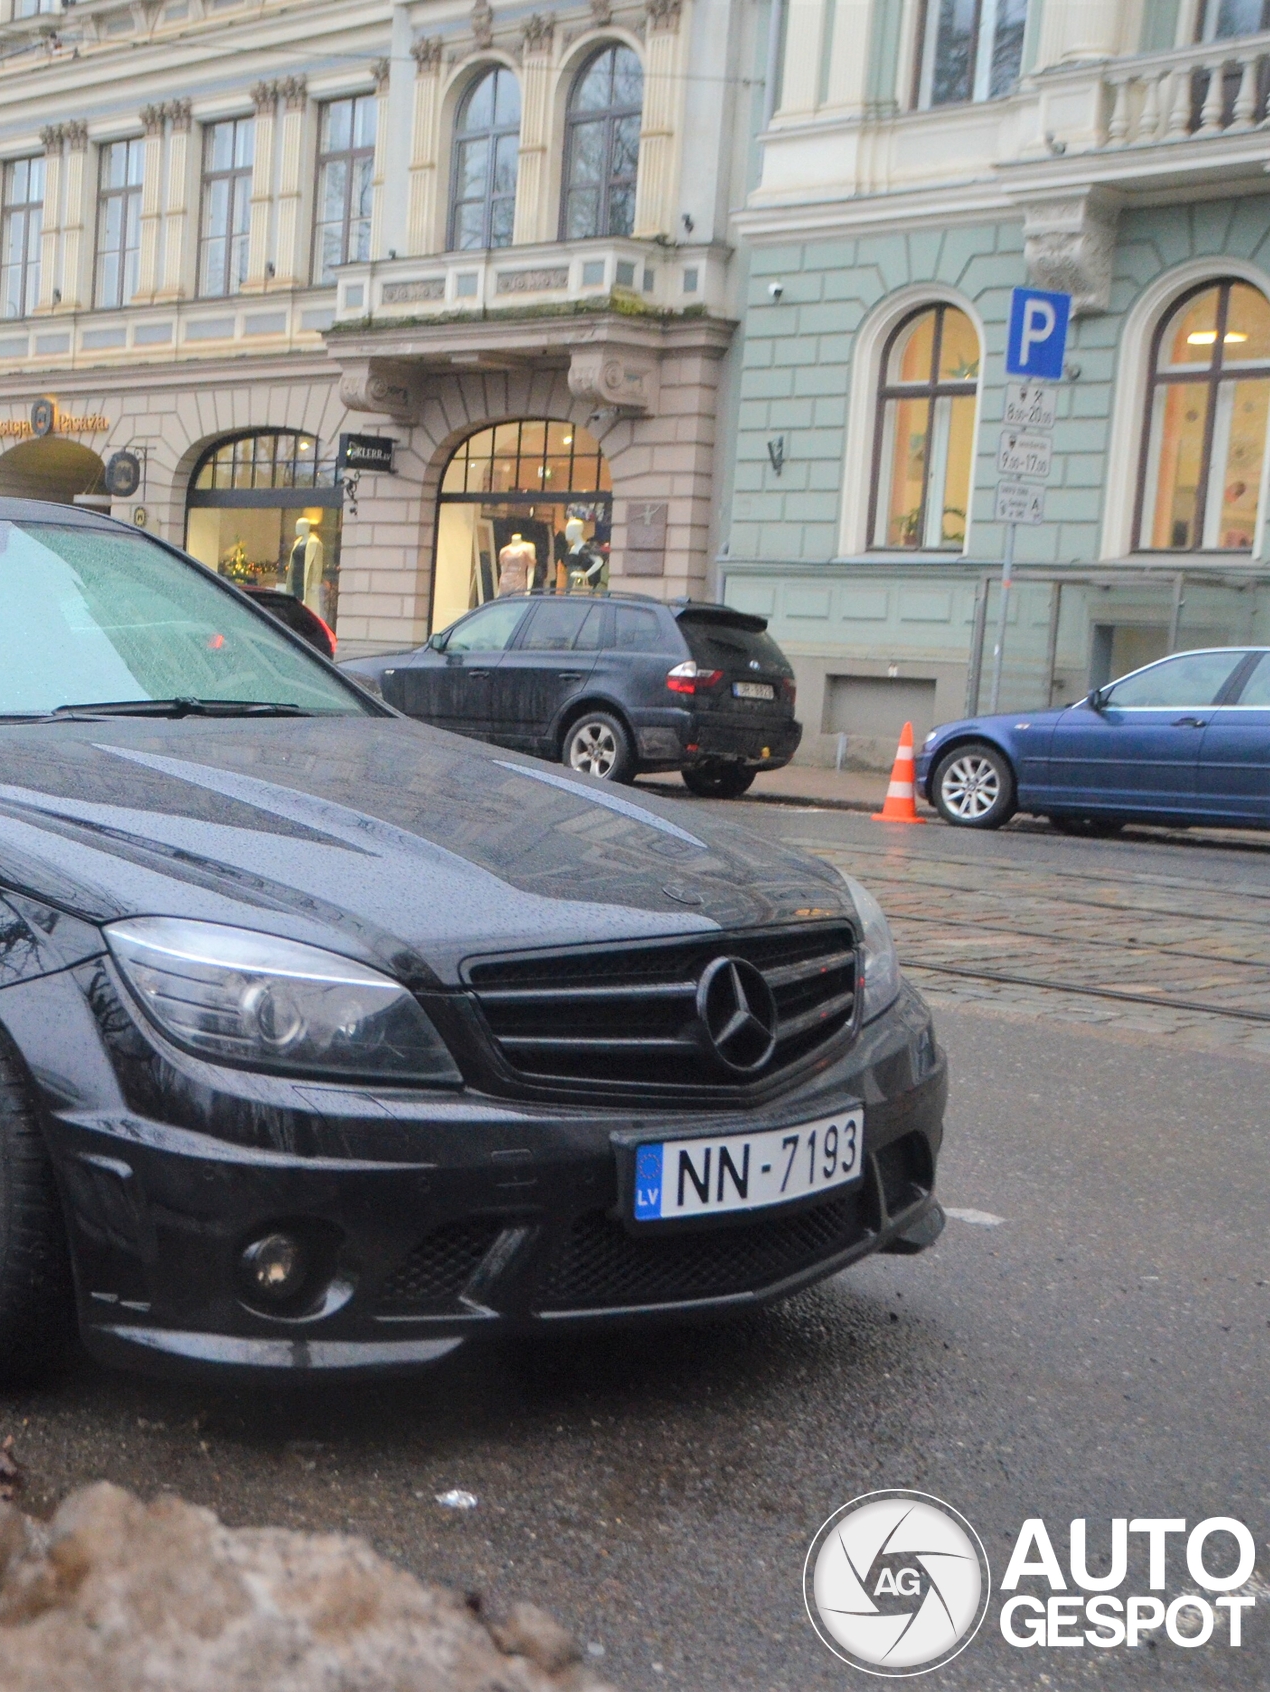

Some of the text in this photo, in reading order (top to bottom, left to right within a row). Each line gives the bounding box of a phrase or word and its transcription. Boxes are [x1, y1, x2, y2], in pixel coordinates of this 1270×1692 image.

[1019, 299, 1056, 367] P
[677, 1118, 858, 1207] NN-7193
[637, 1187, 660, 1207] LV
